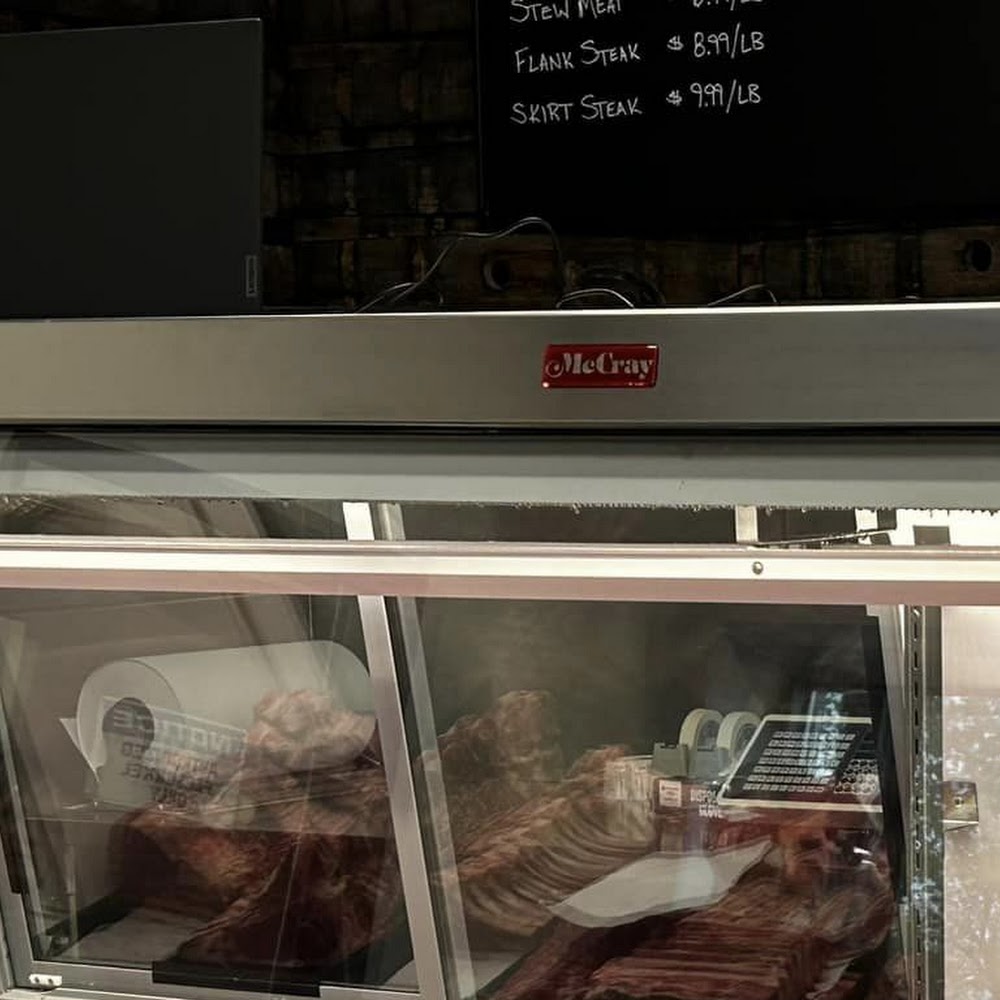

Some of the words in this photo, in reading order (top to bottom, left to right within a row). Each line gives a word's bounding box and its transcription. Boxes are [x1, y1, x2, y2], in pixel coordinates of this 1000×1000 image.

[509, 0, 570, 23] STEW
[515, 47, 575, 73] FLANK
[580, 40, 641, 66] STEAK
[510, 102, 574, 124] SKIRT
[580, 94, 643, 120] STEAK
[545, 352, 653, 379] McCray
